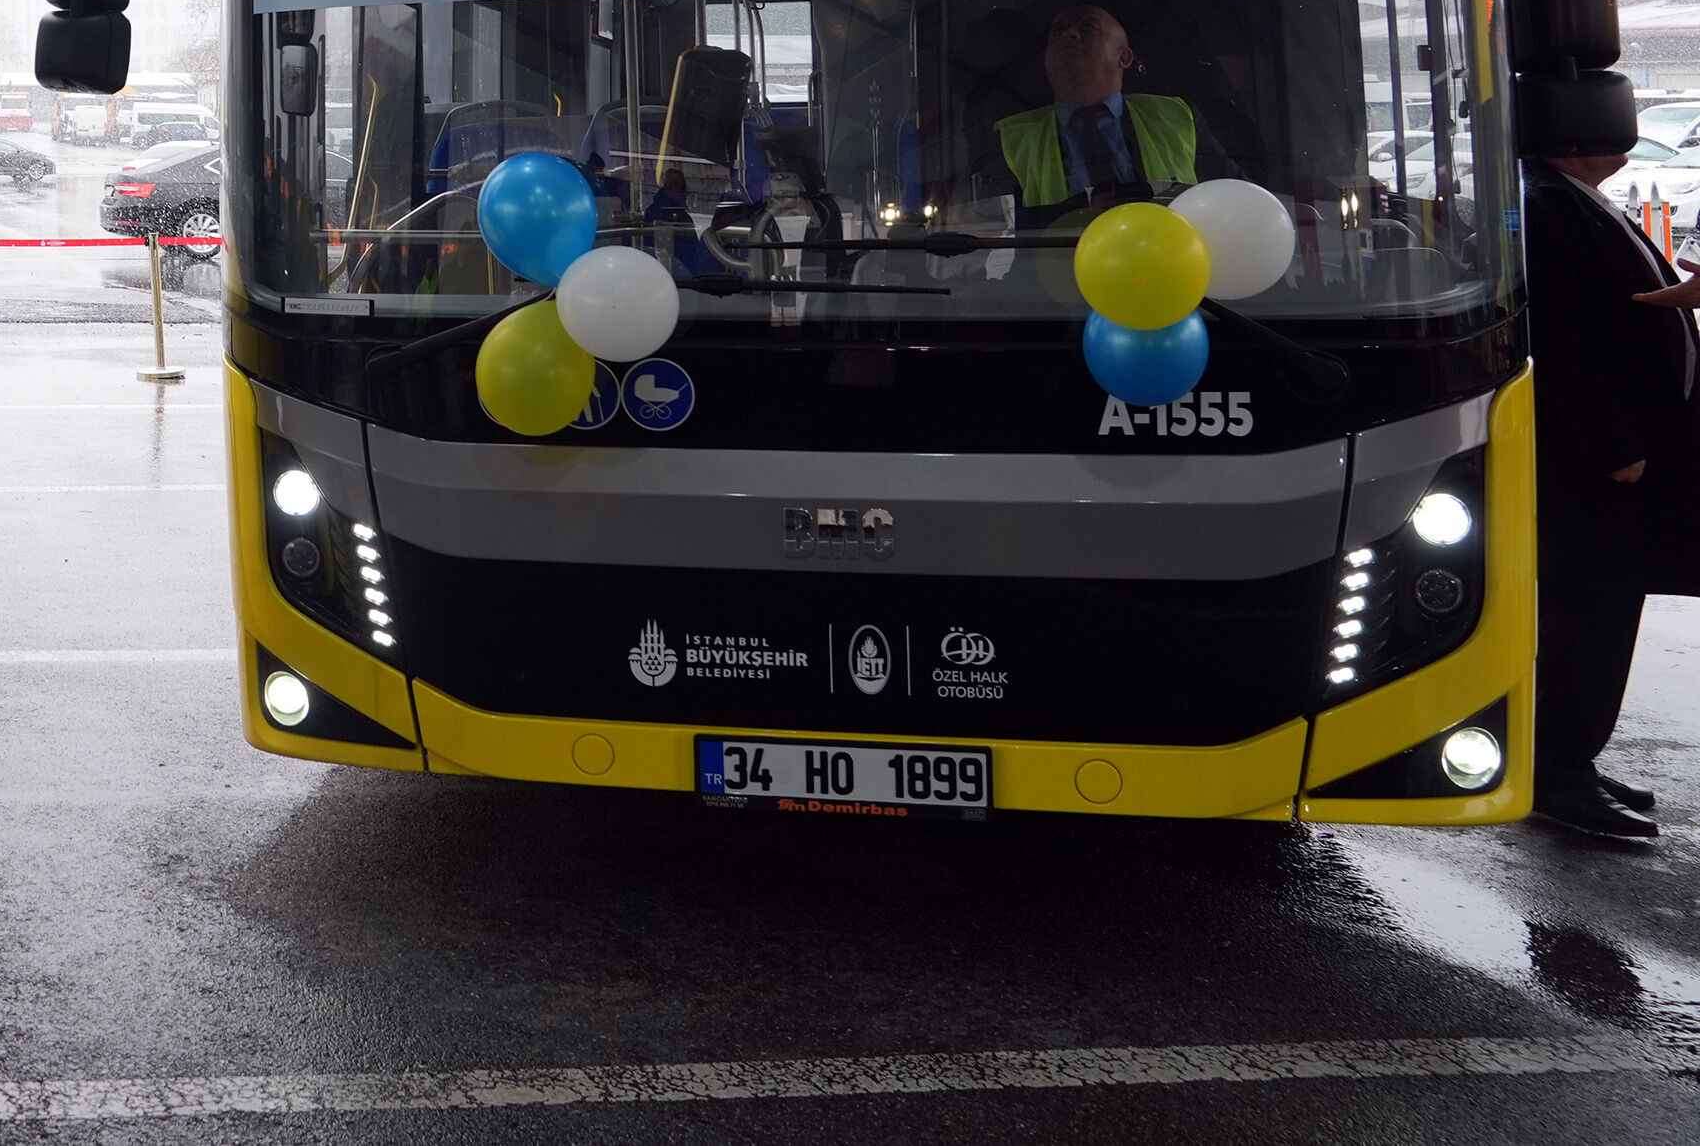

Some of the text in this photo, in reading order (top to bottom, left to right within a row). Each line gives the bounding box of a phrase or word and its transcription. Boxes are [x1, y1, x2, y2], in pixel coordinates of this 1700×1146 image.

[1098, 392, 1254, 437] A-1555
[783, 507, 895, 559] BMC
[686, 634, 769, 647] İSTANBUL
[686, 647, 808, 668] BÜYÜKŞEHİR
[687, 667, 771, 679] BELEDİYESİ
[932, 668, 1008, 684] ÖZEL HALK
[938, 685, 1004, 699] OTOBÜSÜ
[705, 747, 983, 802] TR 34 HO 1899
